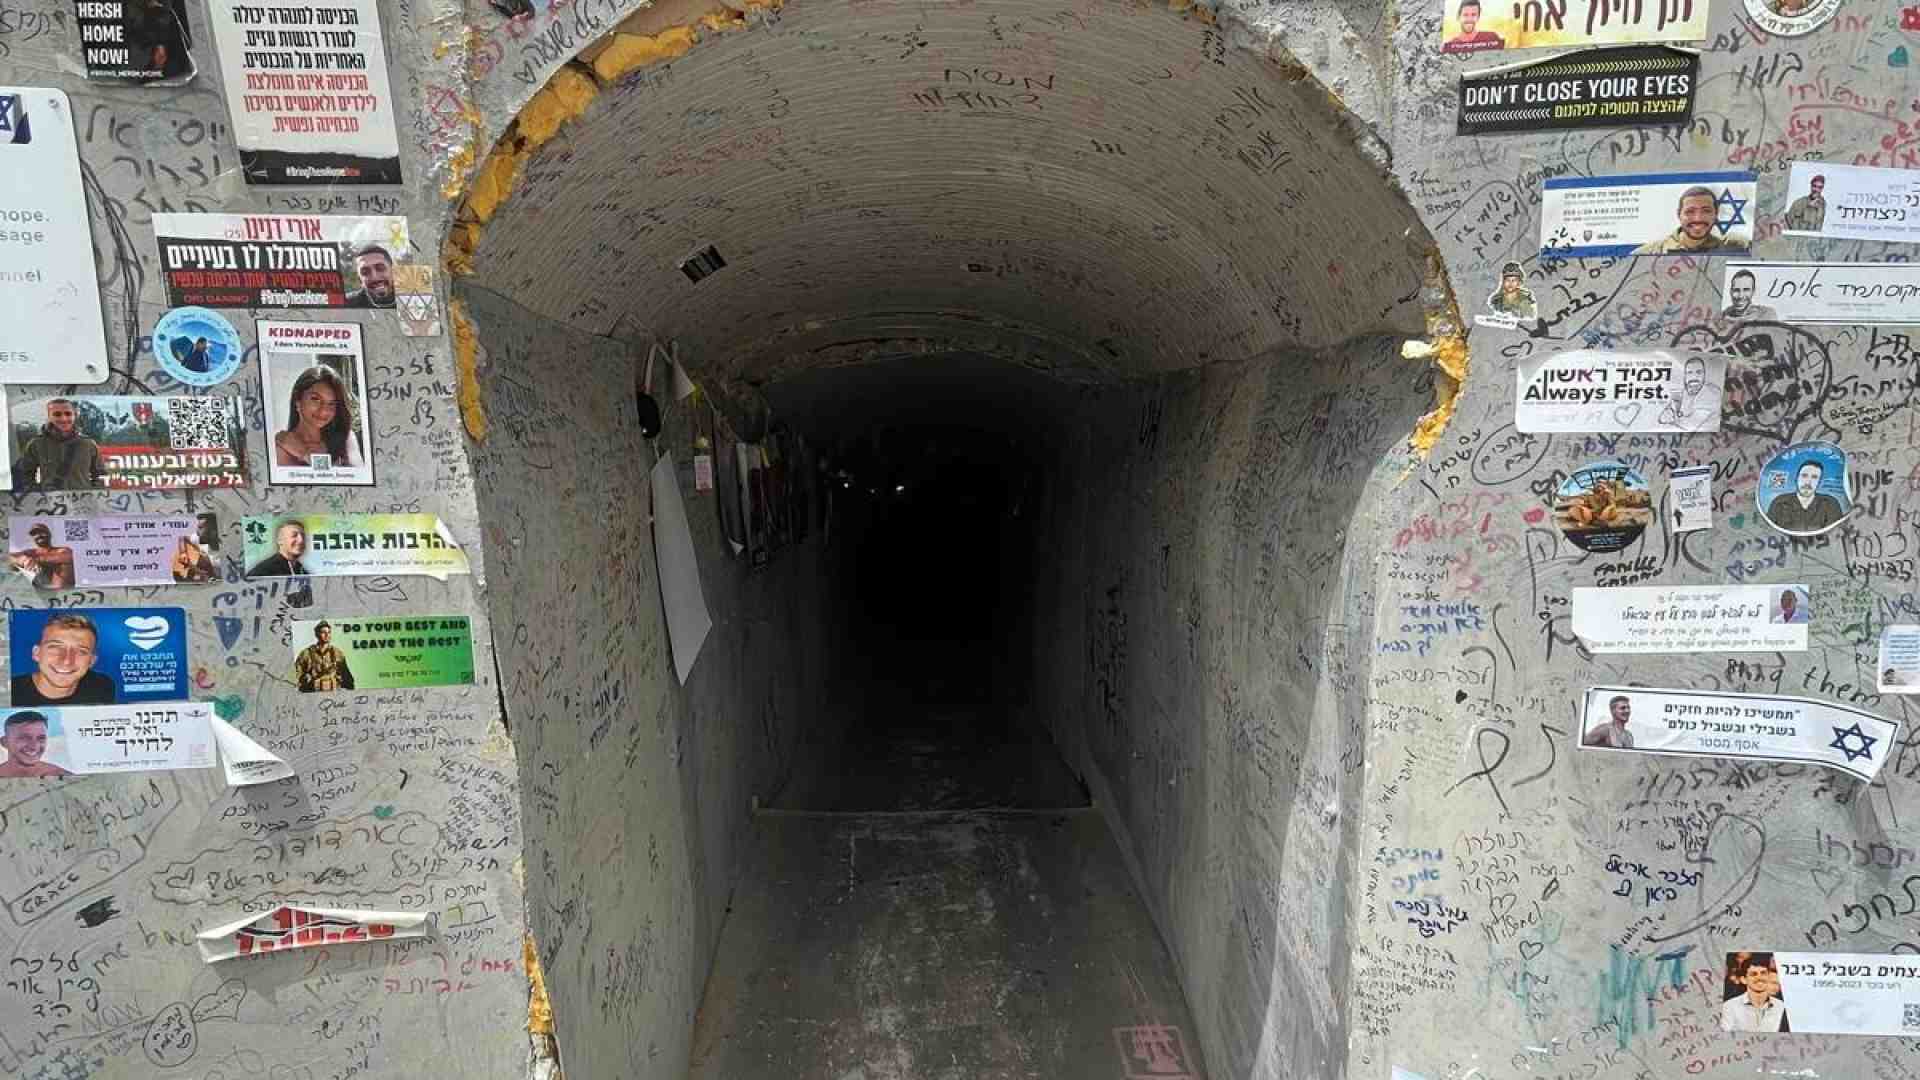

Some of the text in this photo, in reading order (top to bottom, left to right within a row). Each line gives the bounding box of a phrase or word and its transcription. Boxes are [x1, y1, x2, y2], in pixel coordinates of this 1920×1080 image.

[78, 3, 122, 18] HERSH
[232, 6, 358, 25] הכניסה למנהרה יכולה
[83, 25, 124, 42] HOME
[244, 30, 356, 48] לעורר רגשות עזים.
[88, 48, 129, 65] NOW!
[299, 51, 312, 69] על
[315, 53, 366, 69] האחריות
[247, 73, 368, 91] הכניסה אינה מומלצת
[1465, 75, 1689, 107] DON'T CLOSE YOUR EYES
[244, 95, 376, 113] לילדים ולאנשים בסיכון
[272, 117, 359, 132] מבחינה נפשית.
[244, 218, 284, 240] דנינו
[287, 218, 321, 240] אורי
[168, 243, 337, 271] תסתכלו לו בעיניים
[268, 327, 351, 339] KIDNAPPED
[1616, 367, 1671, 382] תמיד
[1524, 383, 1669, 404] Always First.
[109, 453, 238, 468] בעוז ובענווה
[224, 472, 243, 485] גל
[313, 532, 375, 550] אהבה
[365, 621, 401, 633] YOUR
[440, 620, 467, 630] AND
[136, 711, 178, 723] תהנו
[1664, 703, 1703, 716] חזקים
[1706, 706, 1740, 719] להיות
[78, 725, 126, 737] תשכחו
[1701, 721, 1747, 734] ובשביל
[1750, 724, 1796, 736] בשבילי
[115, 736, 173, 756] לחייך
[1736, 738, 1760, 751] אסף
[1781, 963, 1815, 976] ביבר
[1823, 962, 1870, 977] בשביל
